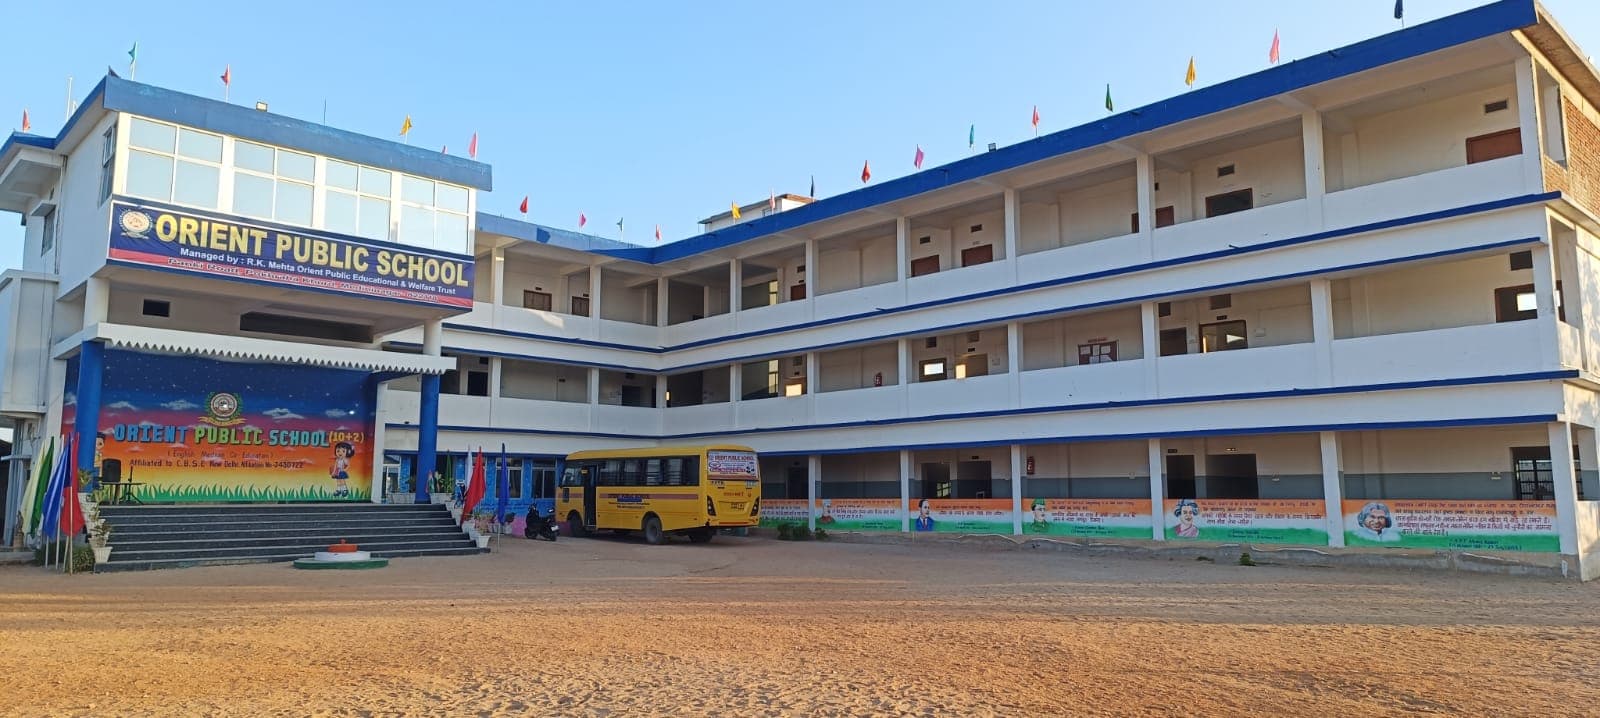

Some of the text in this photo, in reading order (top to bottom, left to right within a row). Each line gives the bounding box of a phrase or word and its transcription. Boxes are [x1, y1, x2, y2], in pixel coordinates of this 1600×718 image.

[156, 213, 469, 287] ORIENT PUBLIC SCHOOL
[180, 247, 224, 262] Managed
[227, 255, 238, 265] by
[247, 257, 266, 268] R.K.
[268, 261, 295, 271] Mehta
[297, 264, 323, 275] Orient
[325, 269, 351, 280] Public
[353, 273, 399, 287] Educational
[401, 280, 407, 288] &
[408, 281, 436, 292] Welfare
[437, 285, 456, 295] Trust
[113, 423, 365, 447] ORIENT PUBLIC SCHOOL (10+2)
[129, 459, 162, 467] Affiliated
